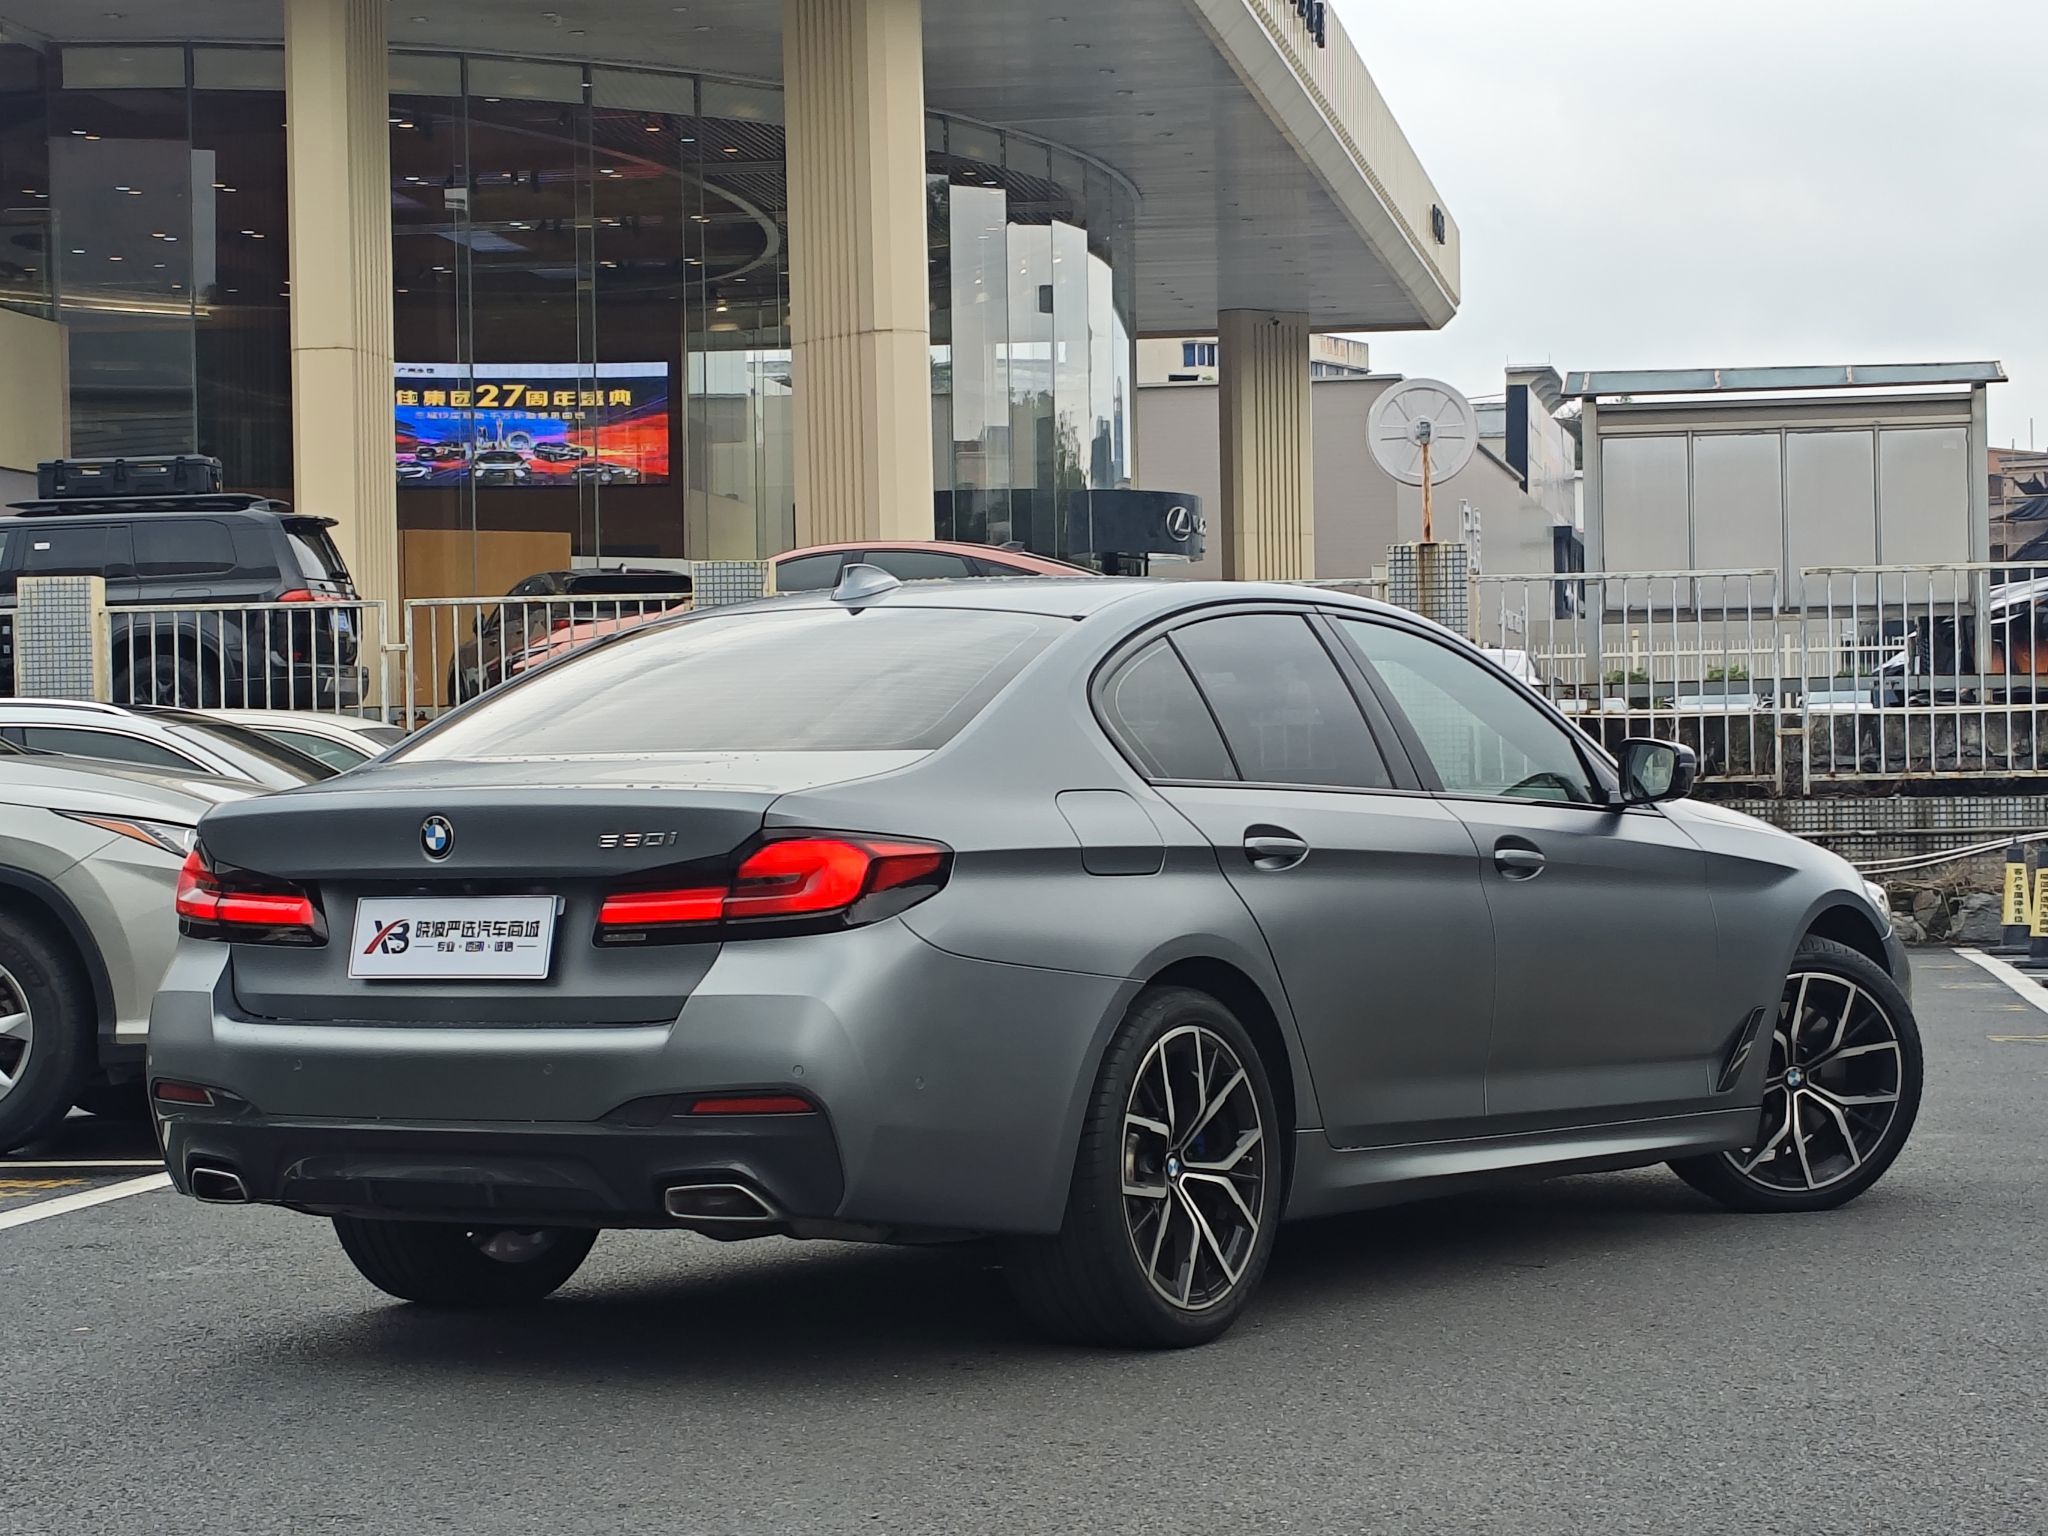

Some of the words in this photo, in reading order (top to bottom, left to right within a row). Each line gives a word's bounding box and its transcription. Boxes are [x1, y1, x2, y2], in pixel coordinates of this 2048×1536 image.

[598, 831, 678, 848] 530i
[415, 920, 540, 938] 晓波严选汽车商城
